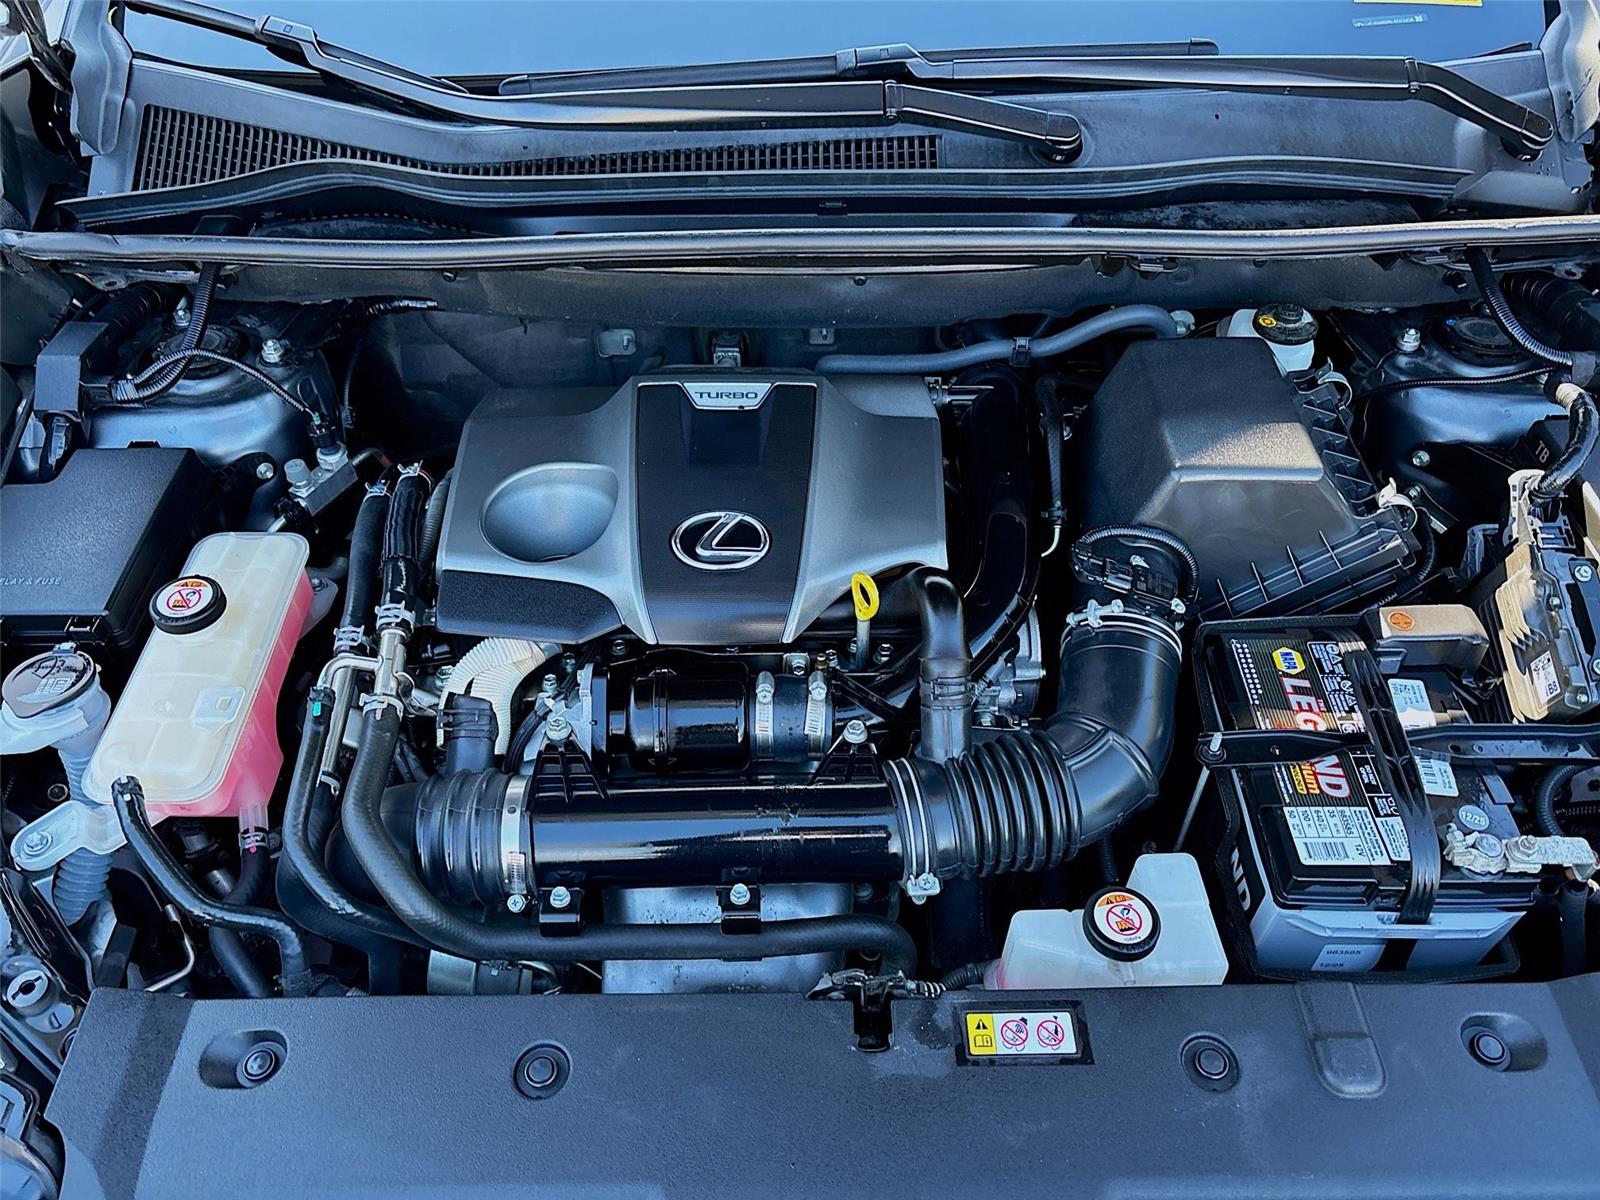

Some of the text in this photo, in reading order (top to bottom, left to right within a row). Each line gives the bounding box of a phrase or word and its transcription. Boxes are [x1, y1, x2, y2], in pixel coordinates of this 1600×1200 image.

[694, 391, 759, 399] TURBO
[1535, 440, 1550, 463] TB
[35, 577, 62, 585] FUSE
[1280, 651, 1299, 671] NAPA
[1287, 810, 1296, 819] 50
[1301, 809, 1310, 822] 100
[1314, 809, 1324, 823] 640
[1327, 809, 1336, 818] 35
[1461, 811, 1486, 826] 12/25
[1355, 844, 1365, 857] 12V
